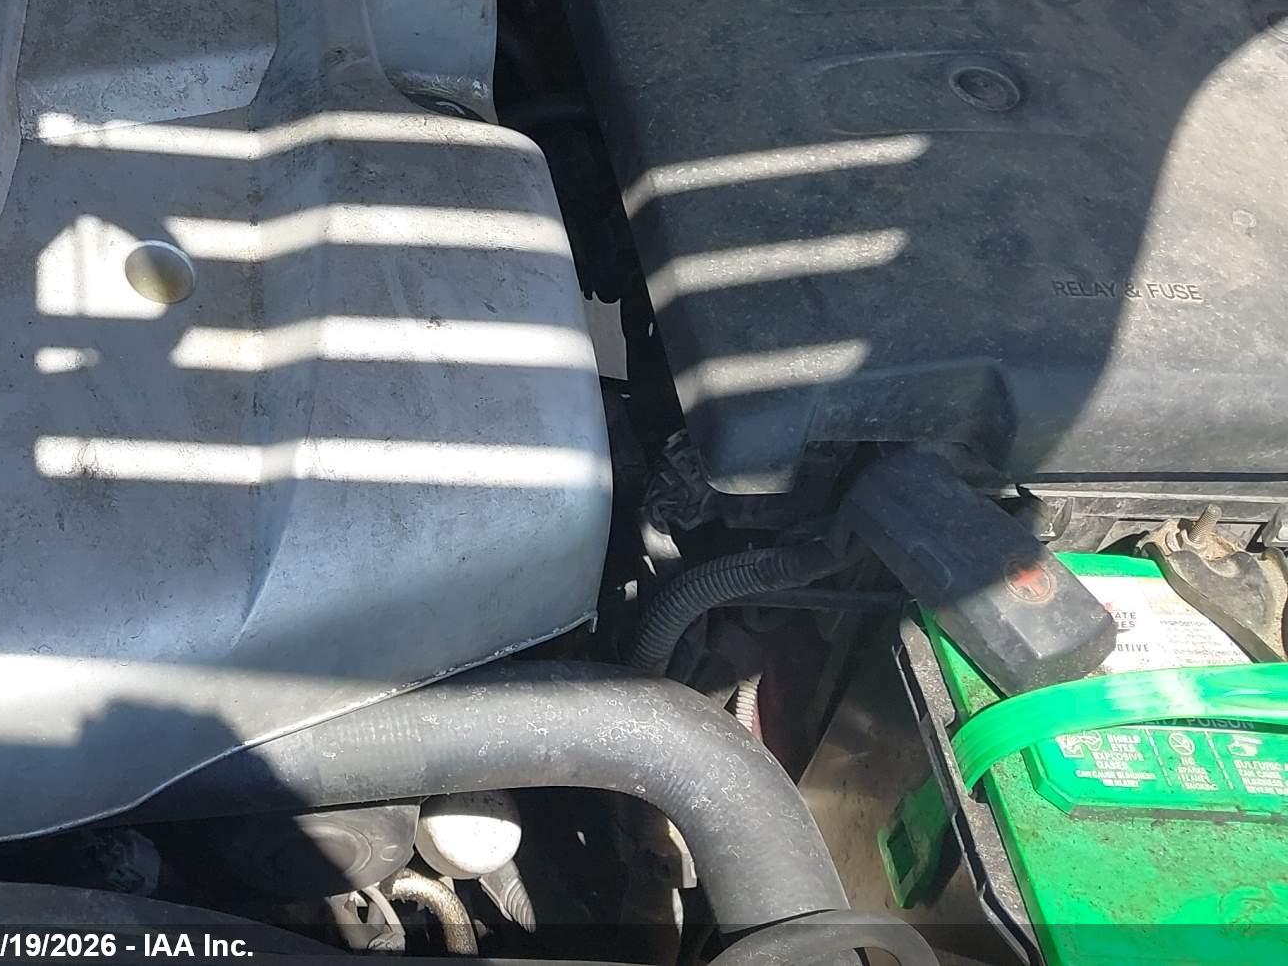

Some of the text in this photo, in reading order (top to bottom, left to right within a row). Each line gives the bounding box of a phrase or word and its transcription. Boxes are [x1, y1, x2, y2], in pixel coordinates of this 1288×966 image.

[1052, 281, 1203, 301] RELAY & FUSE
